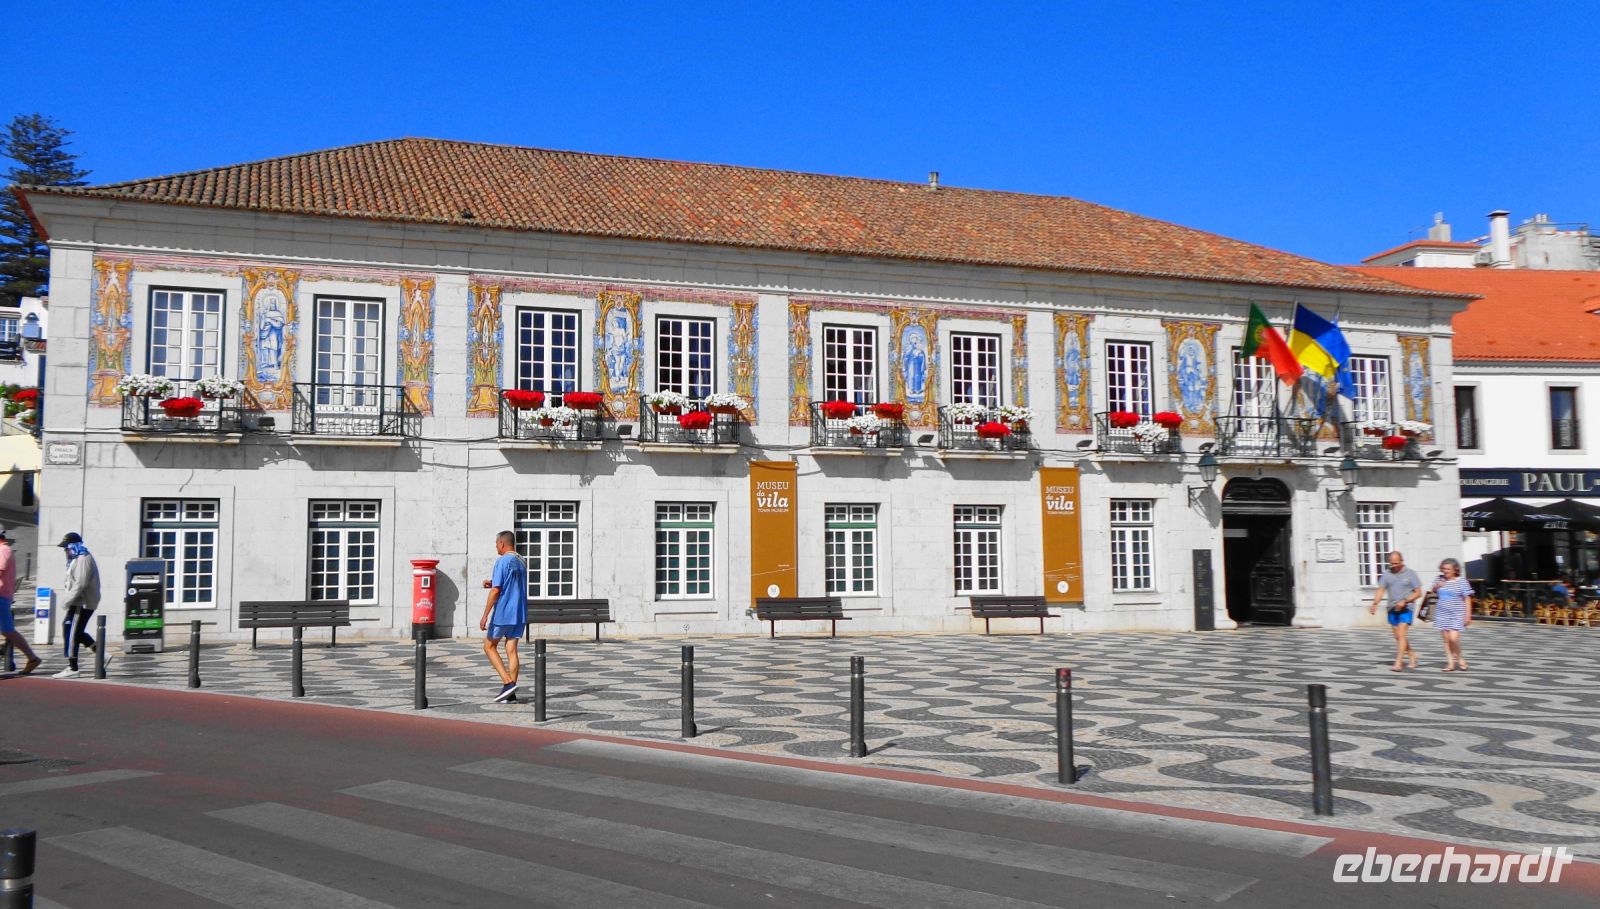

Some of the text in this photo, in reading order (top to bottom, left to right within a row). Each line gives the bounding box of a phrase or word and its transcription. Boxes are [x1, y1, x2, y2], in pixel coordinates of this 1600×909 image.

[757, 481, 789, 490] MUSEU
[1522, 473, 1593, 492] PAUL
[757, 491, 789, 508] vila
[1046, 495, 1074, 510] vila
